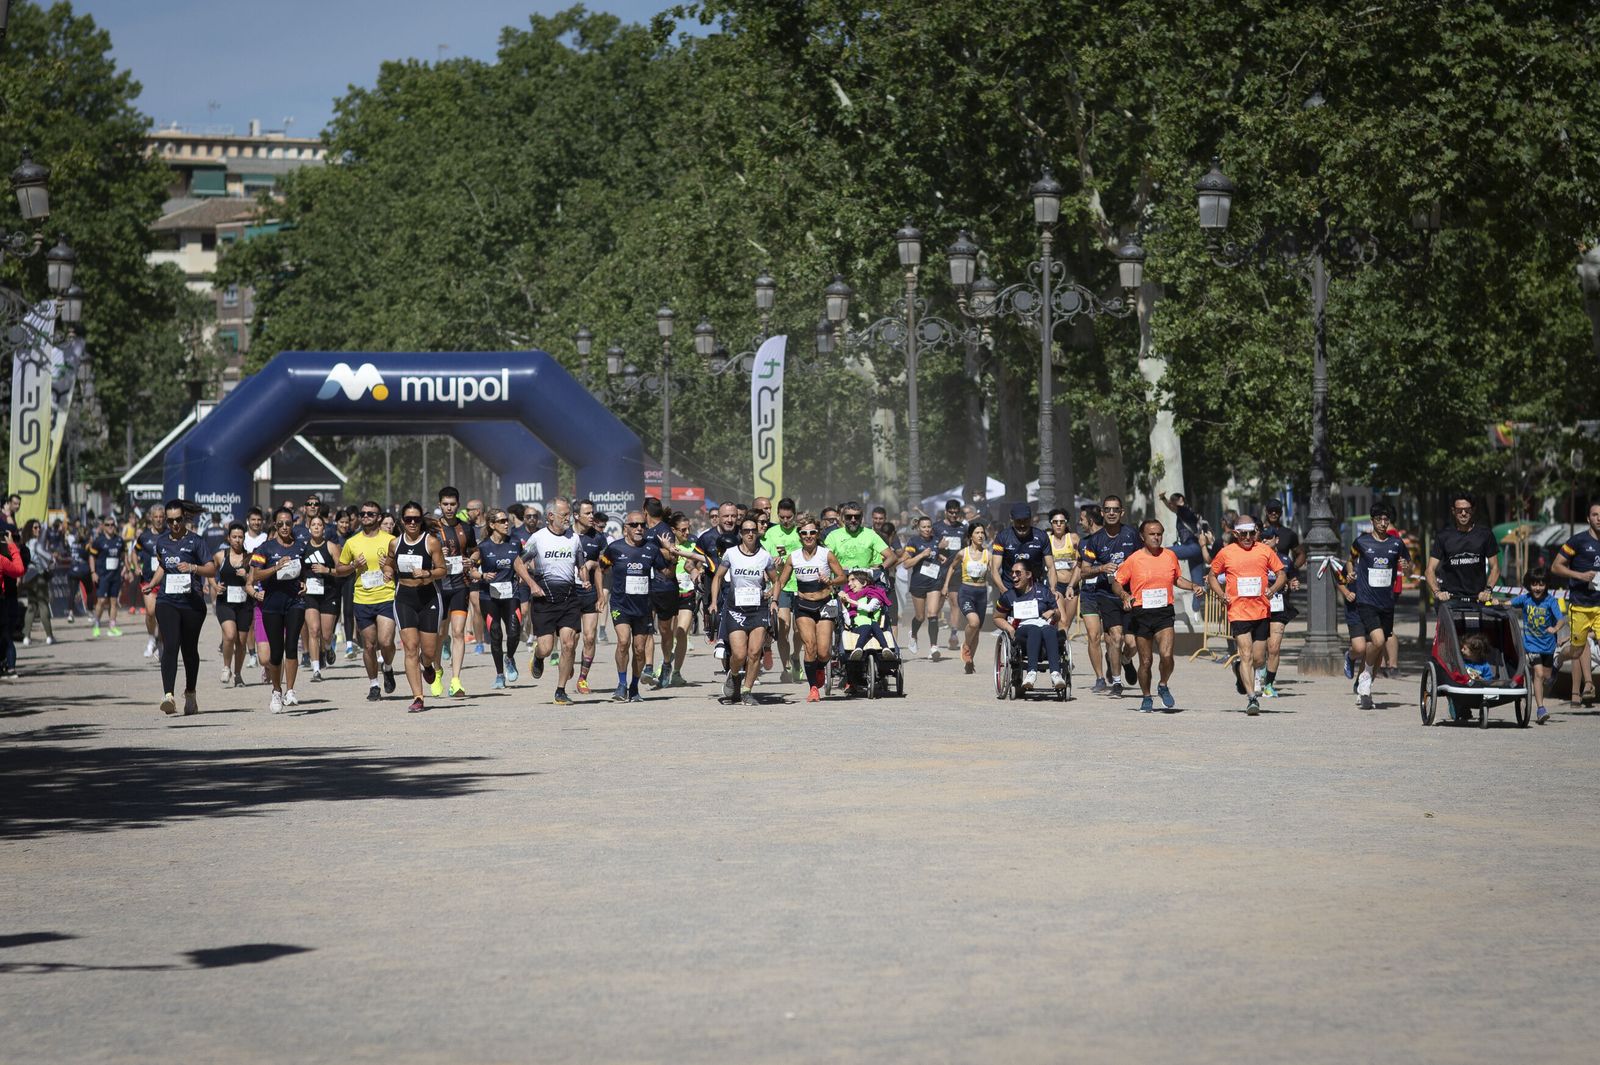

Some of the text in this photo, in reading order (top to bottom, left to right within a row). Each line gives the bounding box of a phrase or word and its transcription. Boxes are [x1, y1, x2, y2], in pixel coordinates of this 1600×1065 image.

[401, 367, 509, 409] mupol
[194, 491, 241, 503] fundación
[515, 482, 544, 502] RUTA
[588, 491, 635, 502] fundación
[596, 501, 627, 513] mupol
